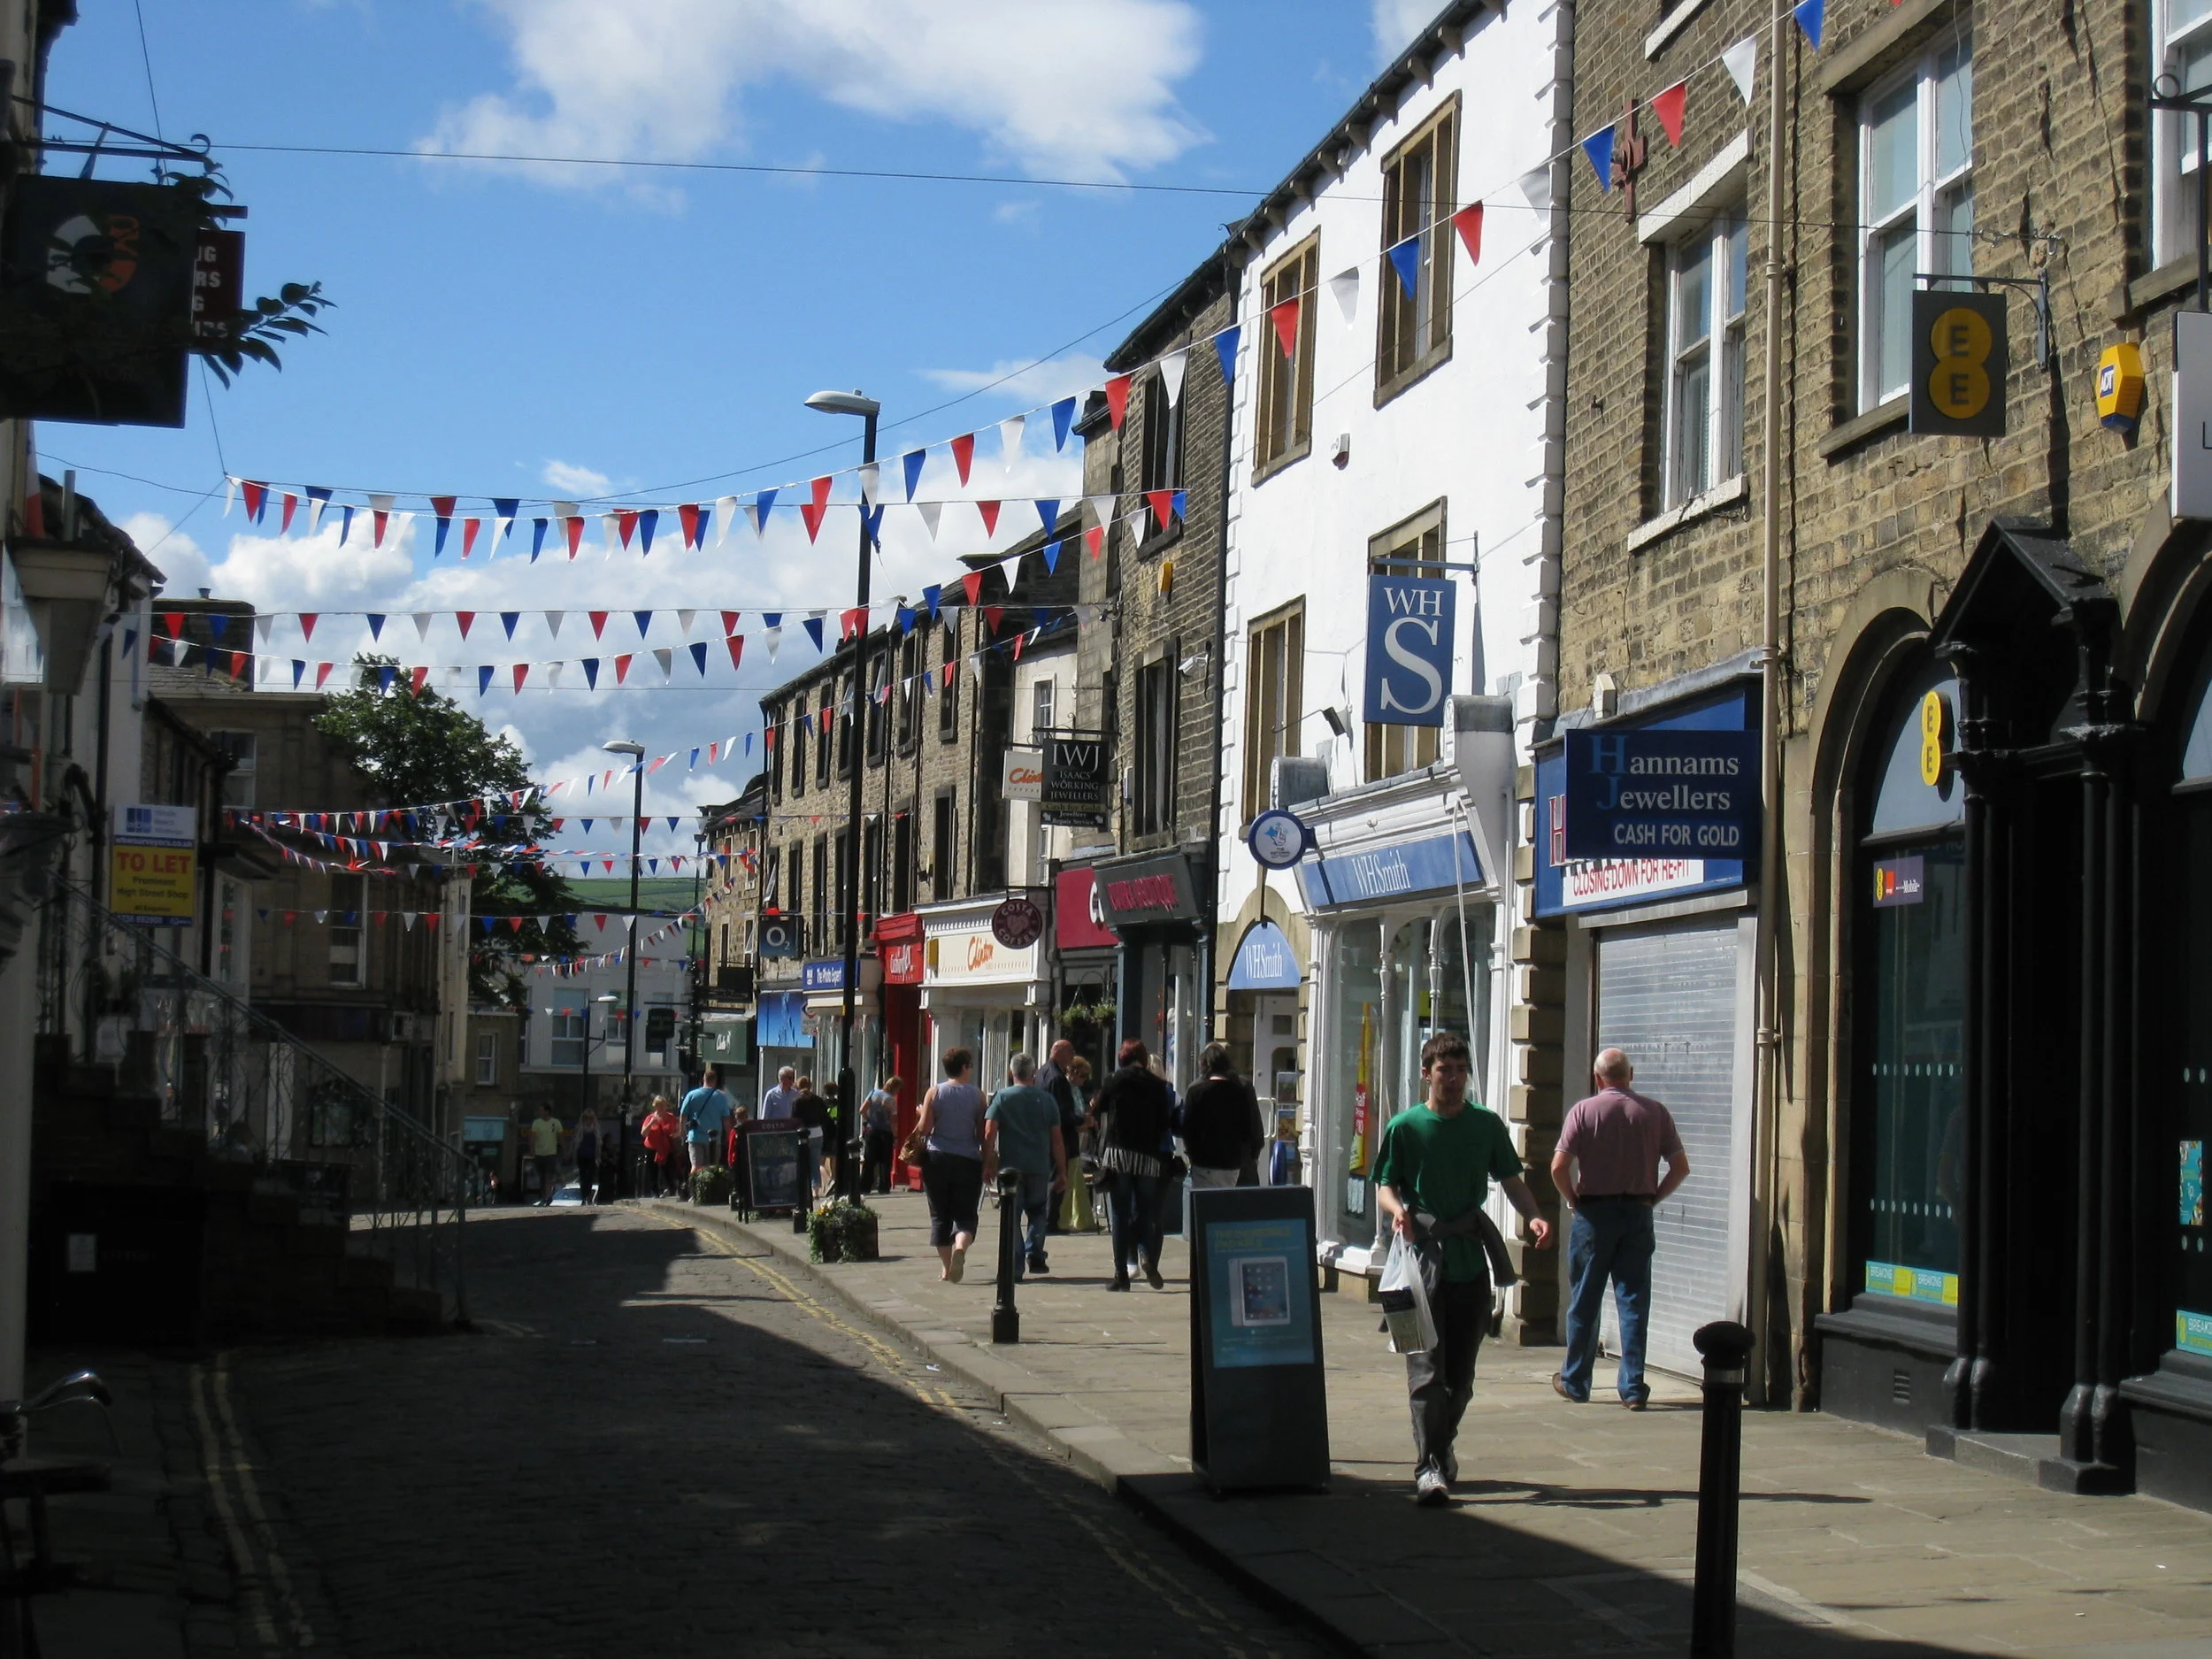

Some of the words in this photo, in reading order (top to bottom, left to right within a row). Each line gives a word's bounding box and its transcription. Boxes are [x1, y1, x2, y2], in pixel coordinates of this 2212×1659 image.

[2100, 369, 2115, 392] ADT
[1383, 587, 1444, 617] WH
[1380, 617, 1443, 715] S
[1051, 743, 1101, 773] IWJ
[1588, 734, 1740, 776] Hannams
[1050, 780, 1100, 791] WORKING
[1059, 771, 1092, 780] ISAACS
[1050, 791, 1099, 801] JEWELLERS
[1596, 776, 1732, 810] Jewellers
[1613, 823, 1656, 845] CASH
[1662, 824, 1692, 846] FOR
[1697, 825, 1740, 847] GOLD
[117, 852, 145, 872] TO
[153, 854, 192, 875] LET
[1351, 849, 1411, 896] WHSmith
[133, 876, 177, 887] Prominent
[1572, 865, 1609, 897] CLOSING
[1611, 859, 1639, 890] DOWN
[1640, 858, 1659, 885] FOR
[139, 889, 165, 898] Street
[167, 889, 189, 902] Shop
[1001, 902, 1034, 917] COSTA
[997, 927, 1037, 945] COFFEE
[1245, 941, 1283, 979] WHSmith
